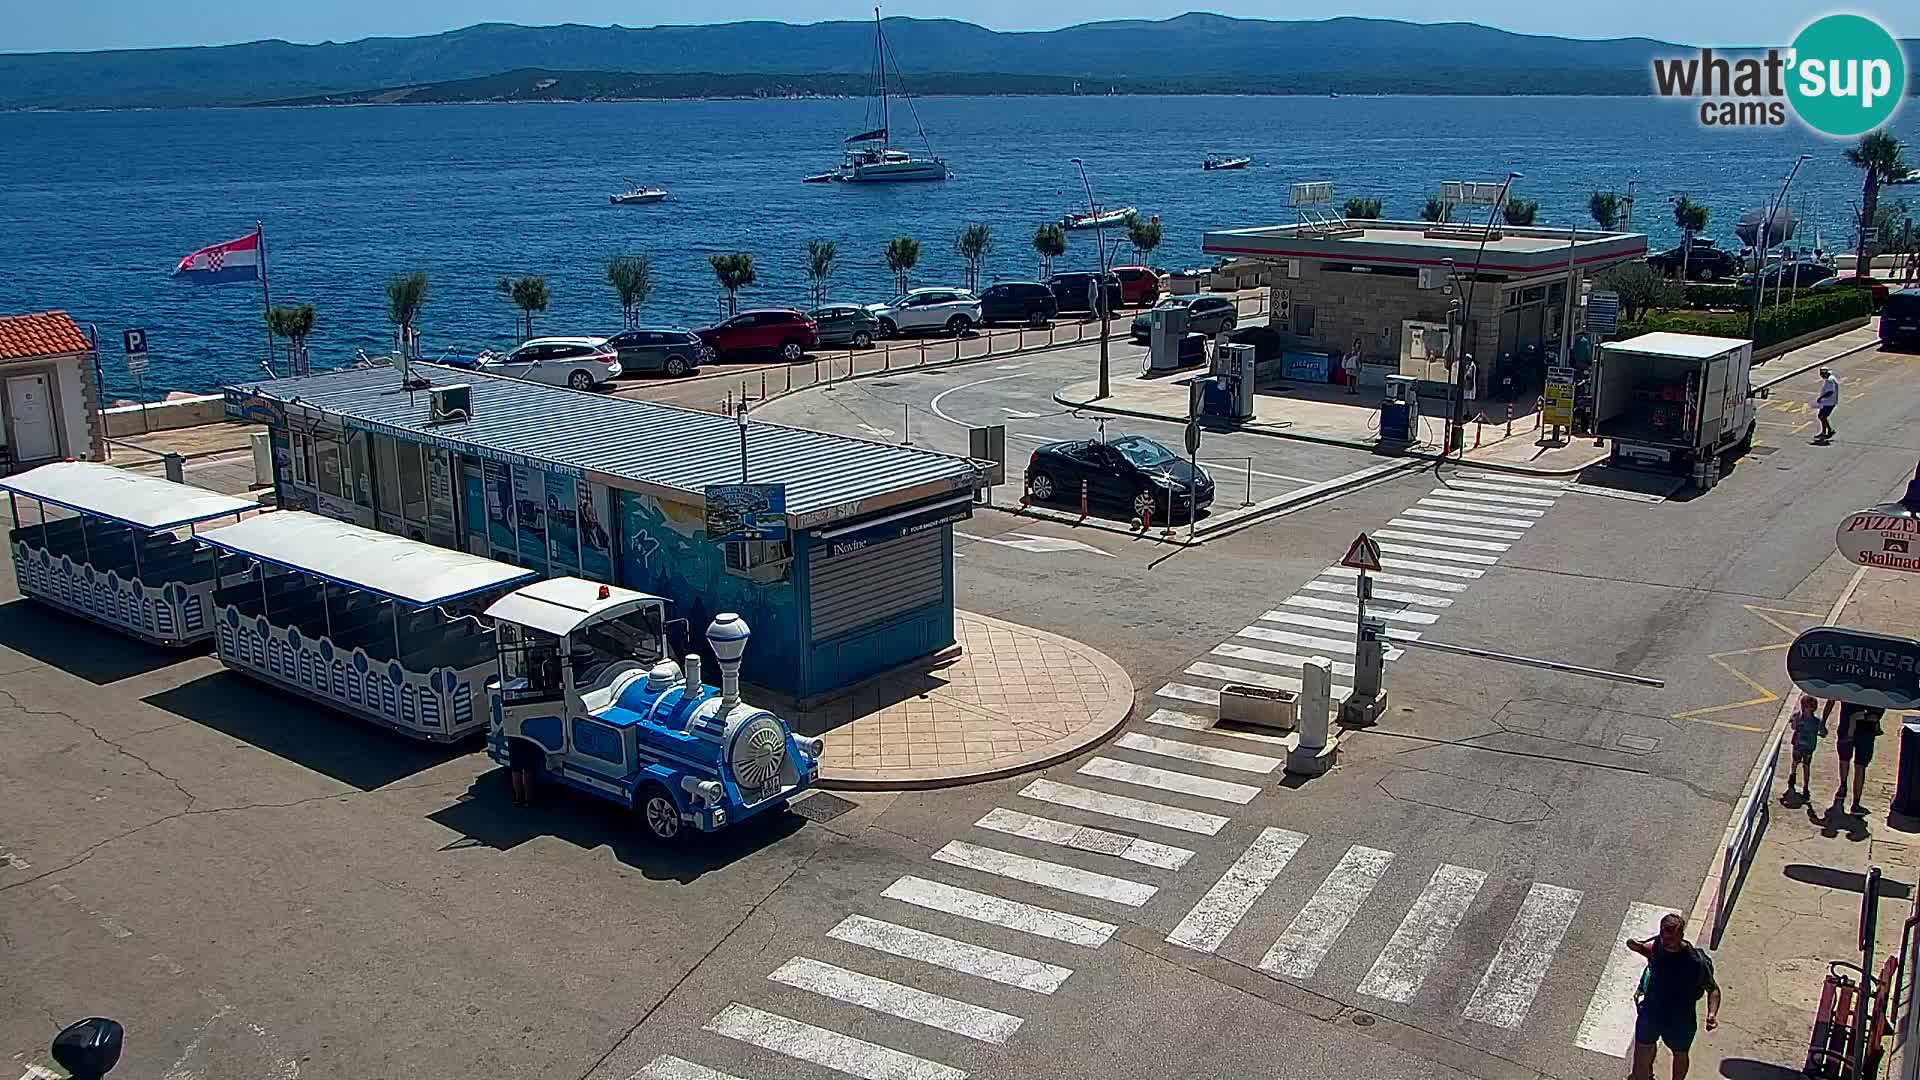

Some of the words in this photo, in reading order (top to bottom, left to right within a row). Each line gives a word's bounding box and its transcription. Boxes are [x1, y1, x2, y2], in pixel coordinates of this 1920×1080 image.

[129, 332, 141, 350] P
[477, 447, 492, 459] BUS
[494, 453, 525, 465] STATION
[527, 458, 553, 472] TICKET
[554, 463, 581, 477] OFFICE
[1870, 665, 1895, 680] bar
